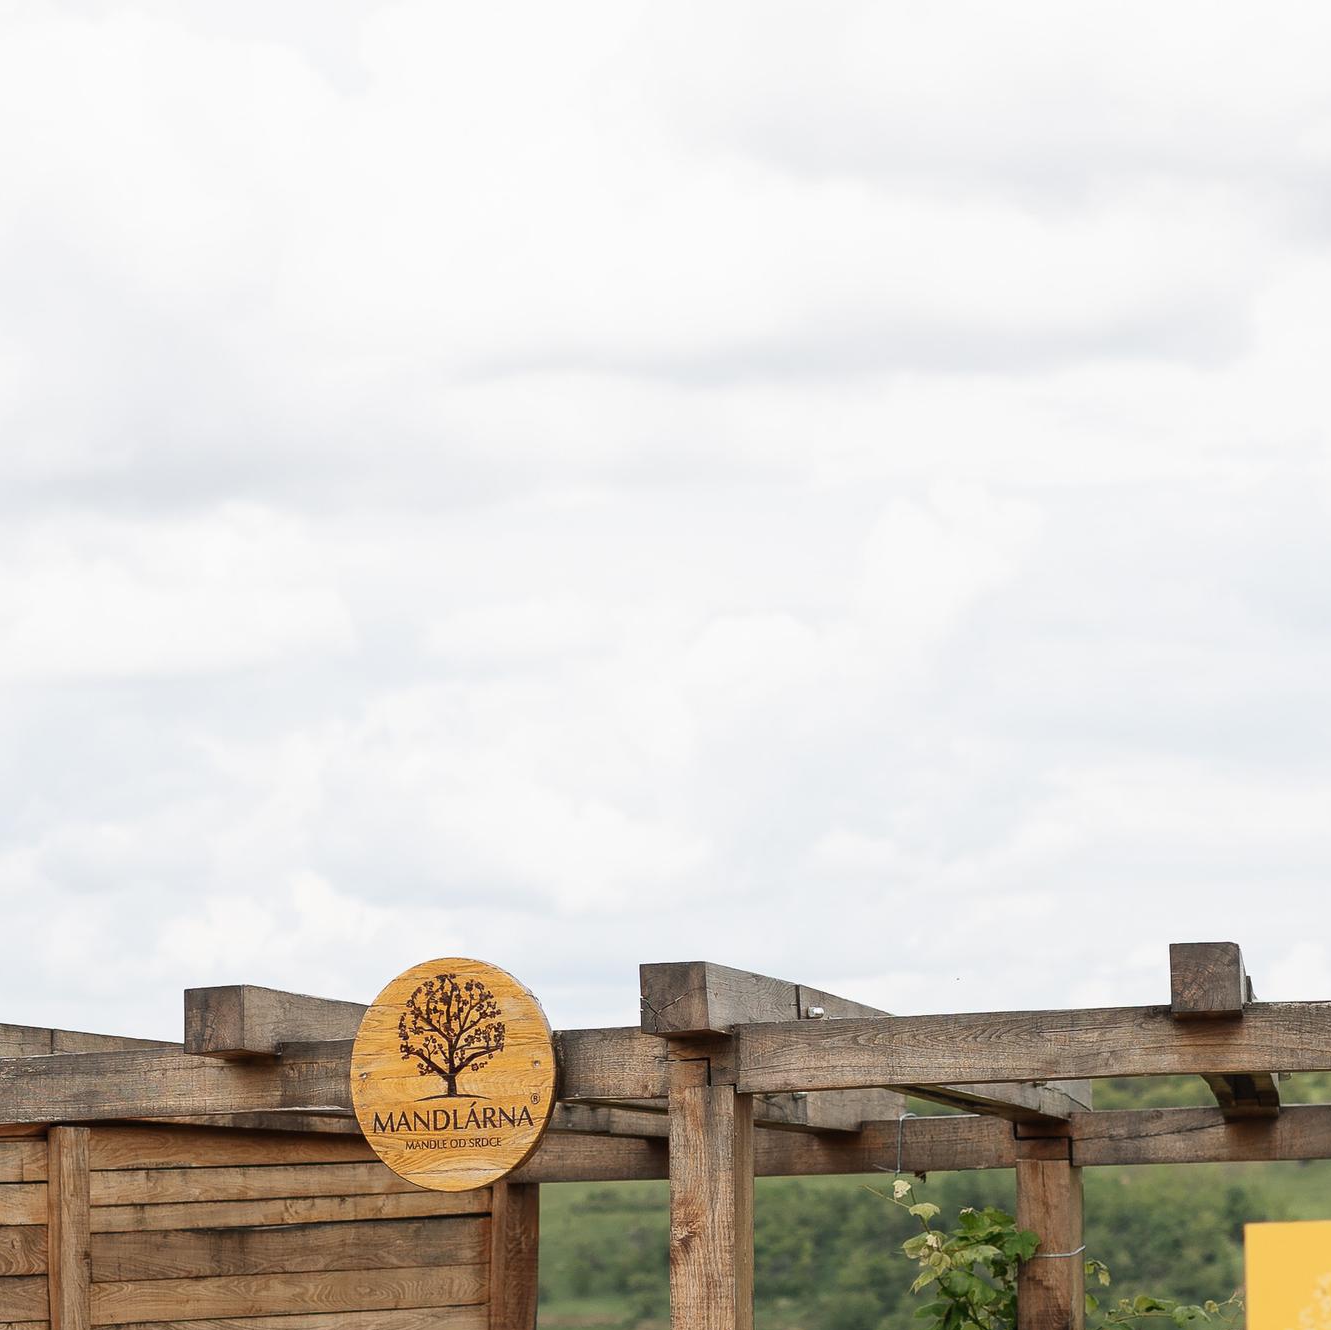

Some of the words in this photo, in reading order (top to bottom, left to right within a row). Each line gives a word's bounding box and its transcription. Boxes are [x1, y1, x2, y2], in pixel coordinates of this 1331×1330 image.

[405, 1138, 448, 1150] MANDLE
[450, 1138, 467, 1148] OD
[469, 1136, 502, 1148] SRDCE
